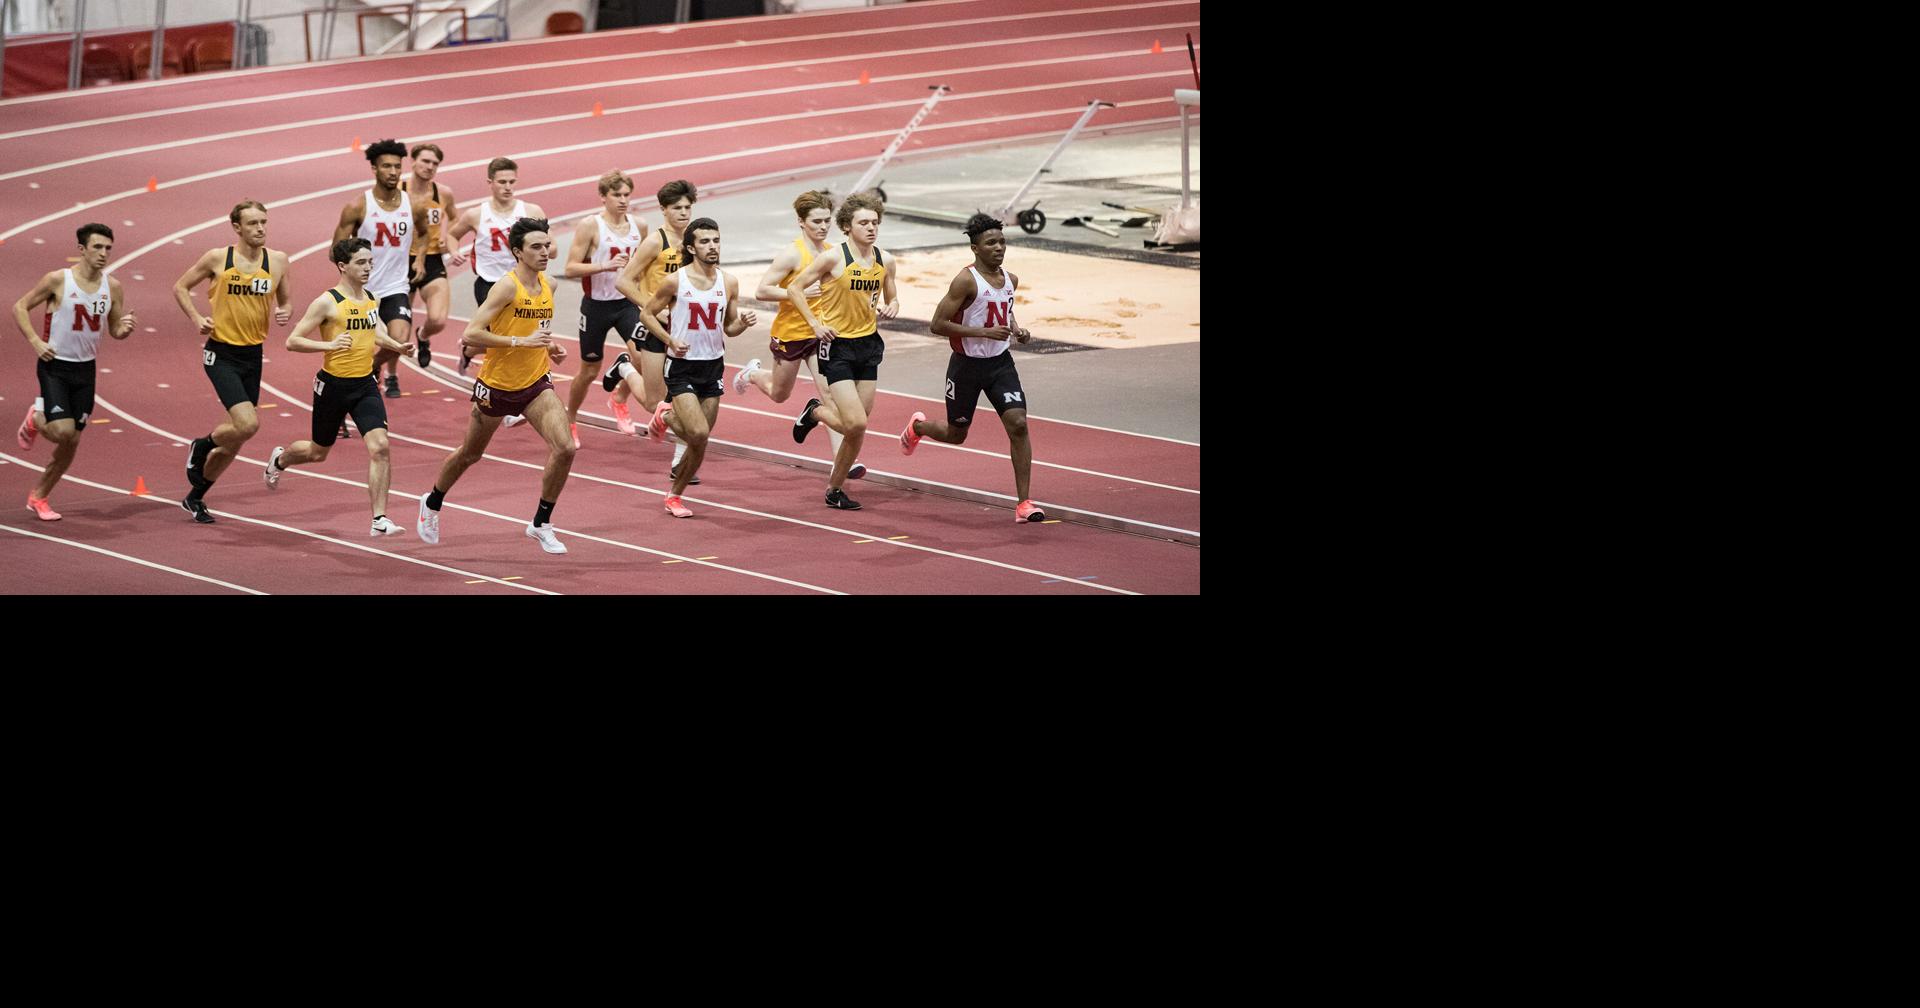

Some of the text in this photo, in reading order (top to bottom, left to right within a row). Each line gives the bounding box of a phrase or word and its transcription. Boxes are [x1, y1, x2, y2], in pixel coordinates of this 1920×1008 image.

[432, 209, 440, 224] 8
[374, 222, 401, 247] N
[398, 222, 408, 236] 9
[254, 280, 268, 292] 14
[850, 279, 880, 291] IOWA
[92, 301, 106, 314] 13
[514, 307, 553, 319] MINNESOT
[1008, 297, 1014, 314] 2
[72, 304, 100, 332] N
[688, 302, 719, 330] N
[719, 306, 725, 321] 1
[984, 302, 1008, 328] N
[635, 325, 647, 340] 6
[820, 342, 829, 359] 5
[477, 384, 489, 400] 12
[946, 381, 954, 398] 2
[1003, 391, 1023, 403] N
